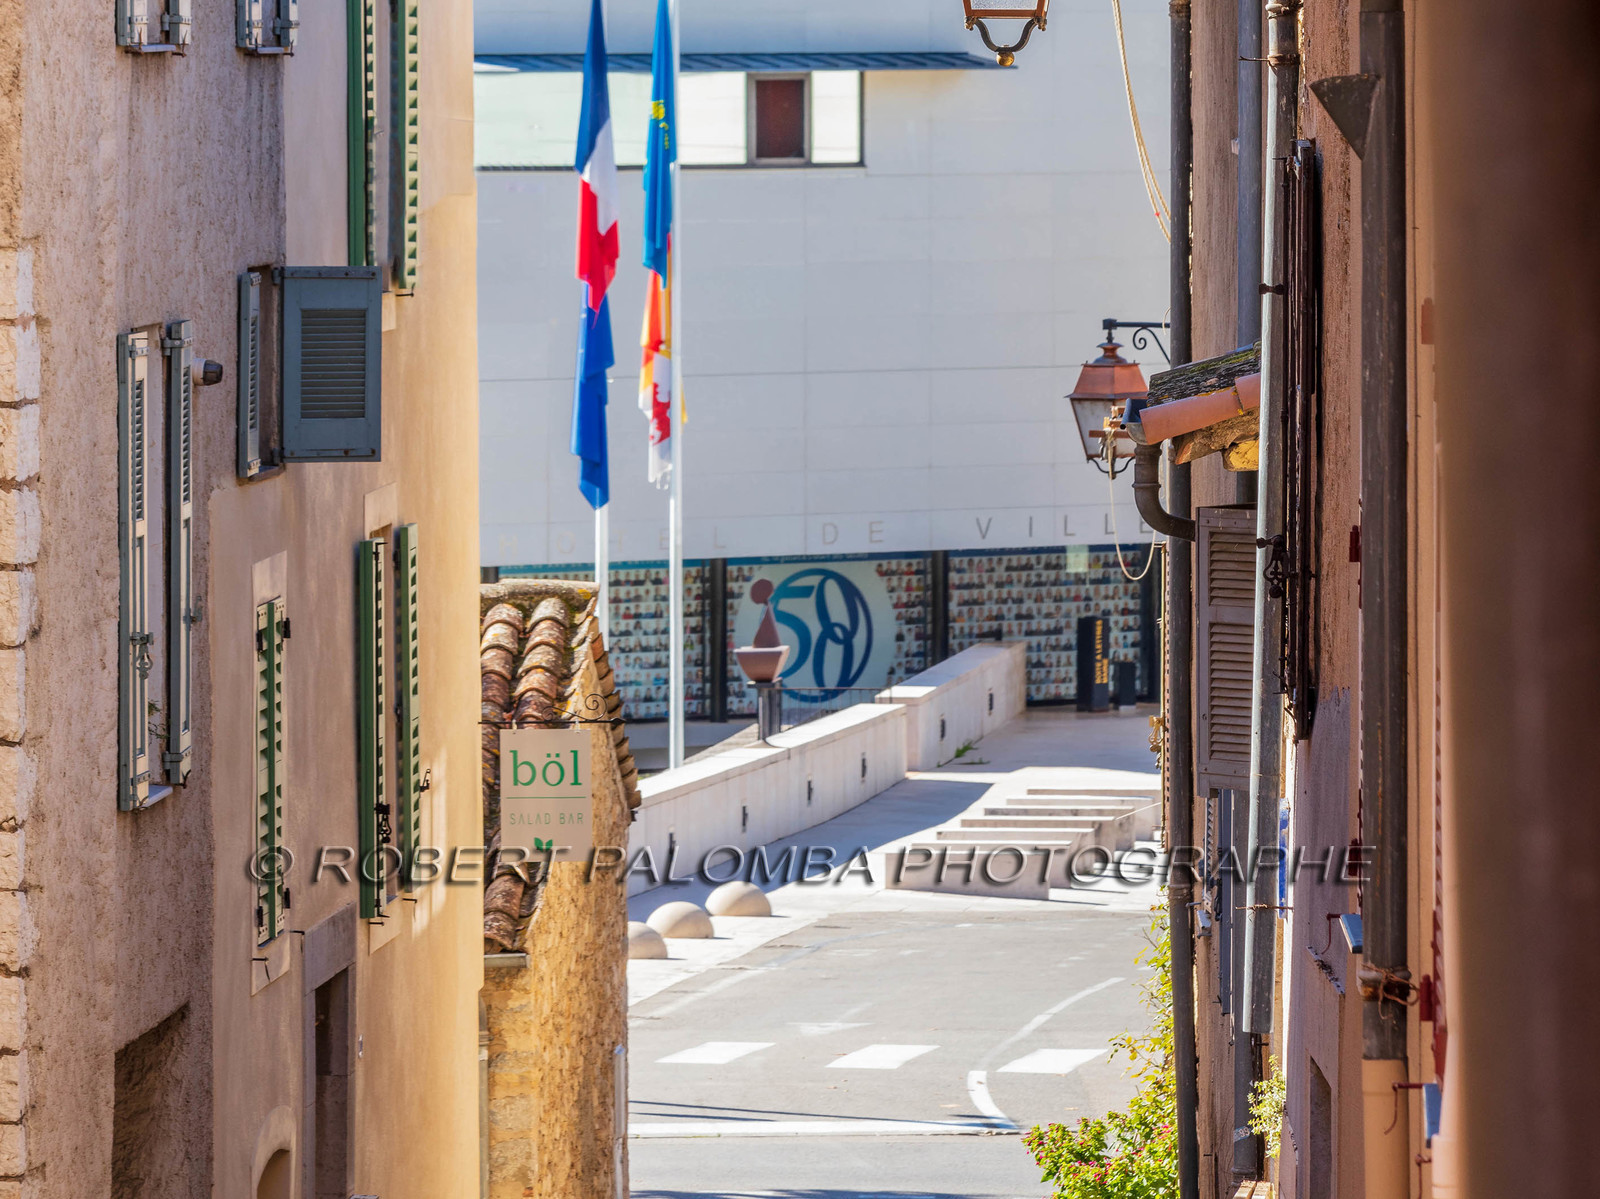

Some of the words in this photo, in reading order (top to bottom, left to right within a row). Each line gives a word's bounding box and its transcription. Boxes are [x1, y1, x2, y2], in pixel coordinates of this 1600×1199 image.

[499, 526, 727, 555] HOTEL
[821, 521, 885, 545] DE
[509, 749, 583, 787] böl
[510, 812, 552, 825] SALAD
[559, 812, 585, 825] BAR
